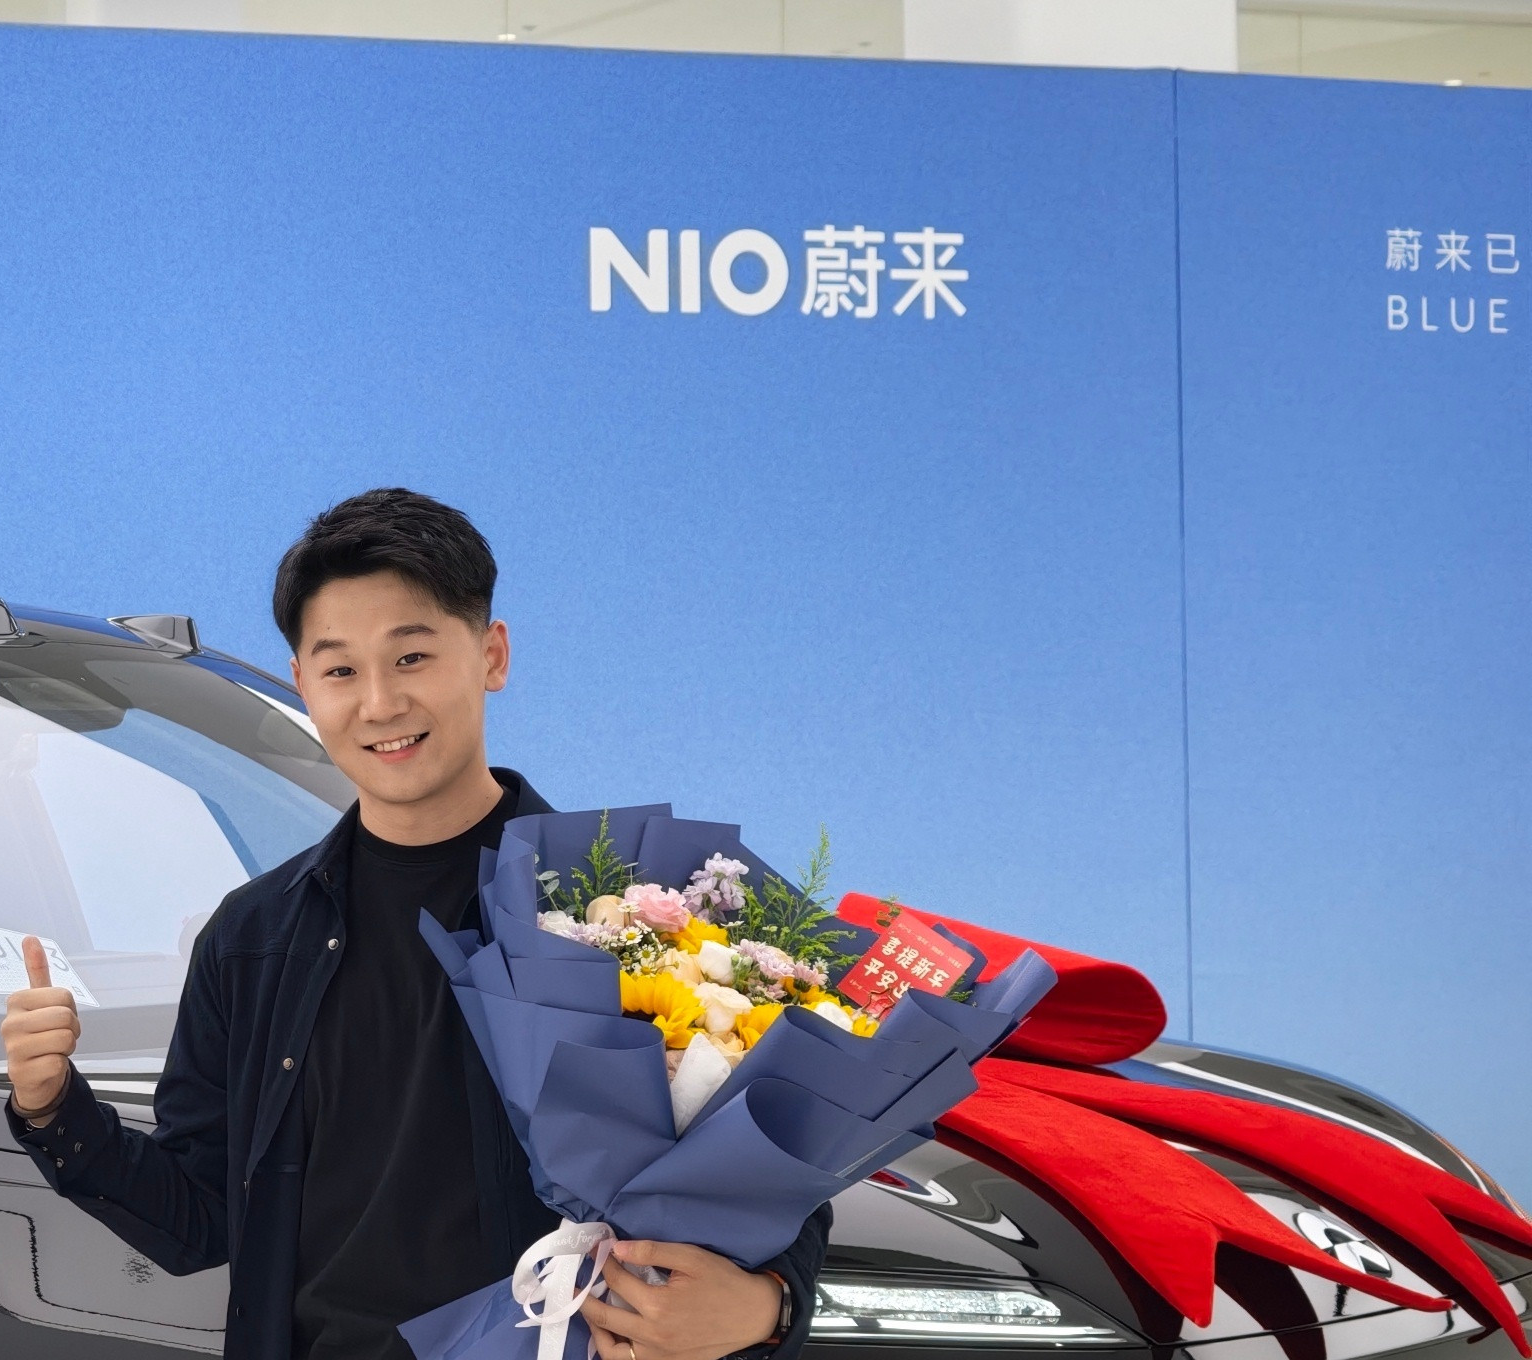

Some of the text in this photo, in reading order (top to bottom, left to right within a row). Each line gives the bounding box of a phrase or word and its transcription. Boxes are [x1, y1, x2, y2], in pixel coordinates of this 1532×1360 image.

[591, 226, 969, 320] NIO 蔚来
[1387, 294, 1510, 334] BLUE
[881, 936, 950, 988] 喜提新车
